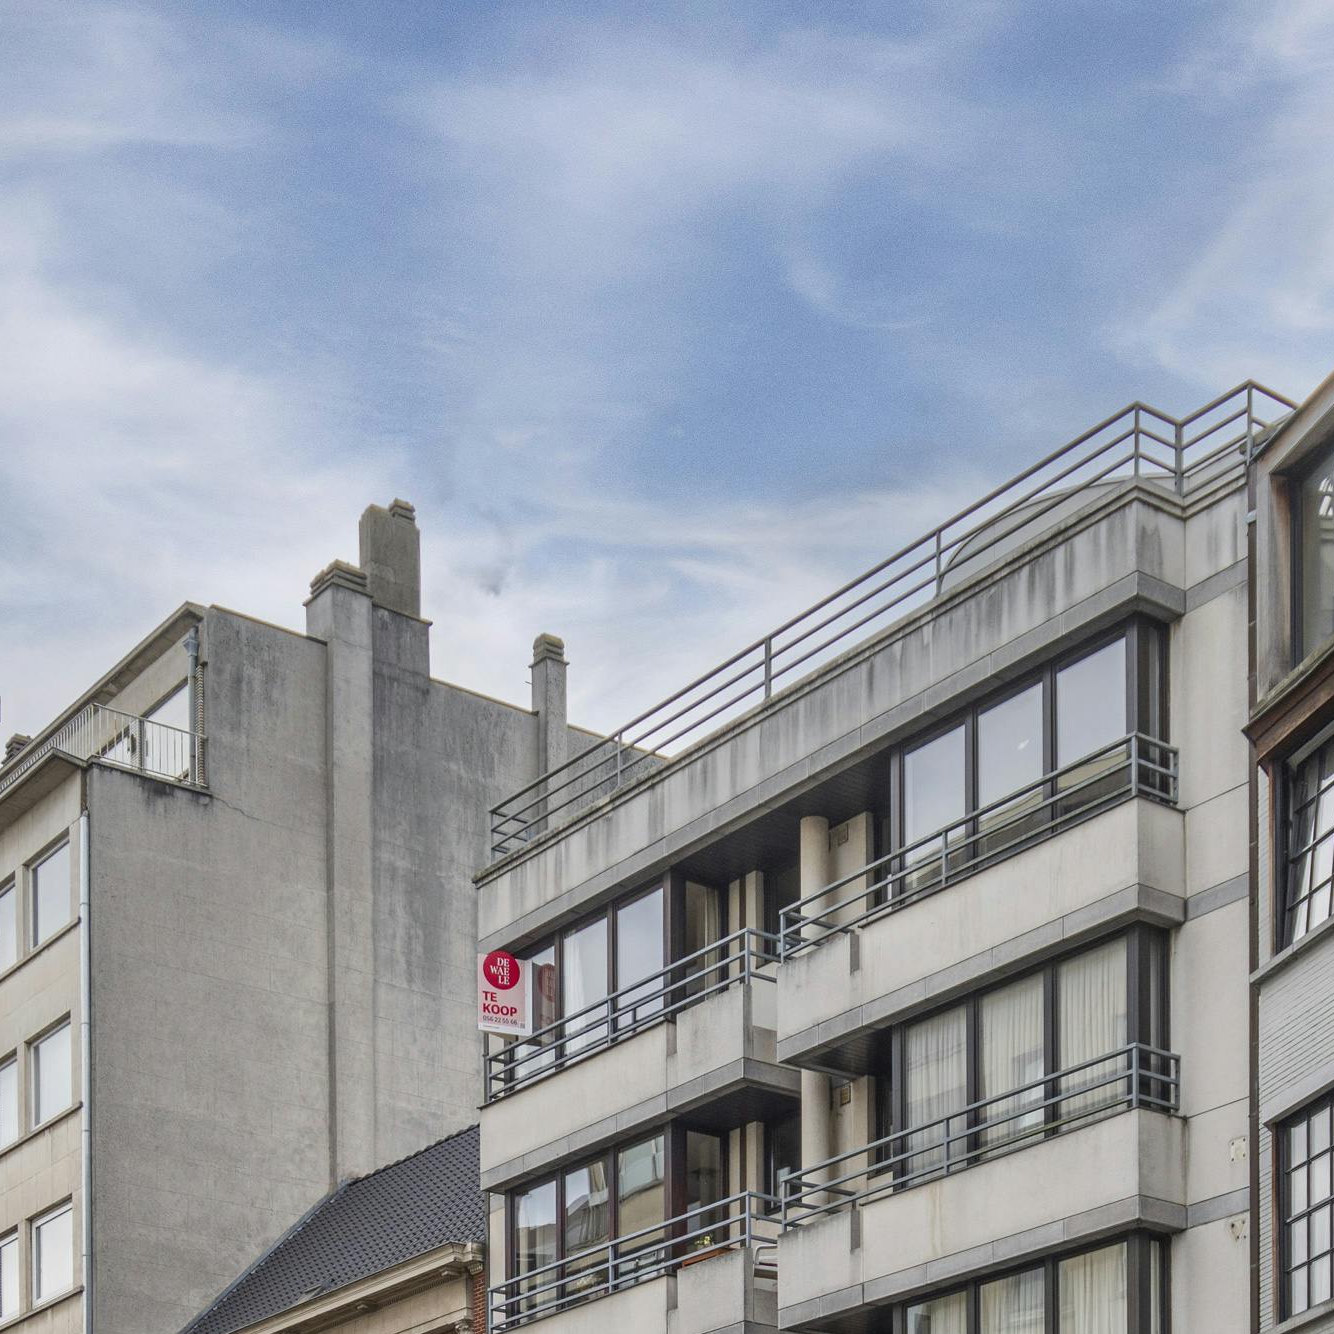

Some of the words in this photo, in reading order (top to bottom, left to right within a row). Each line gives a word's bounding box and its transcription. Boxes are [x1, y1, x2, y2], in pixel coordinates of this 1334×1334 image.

[497, 957, 510, 967] DE
[490, 965, 510, 976] WAE
[498, 976, 510, 985] LE
[482, 991, 497, 1002] TE
[482, 1003, 517, 1016] KOOP
